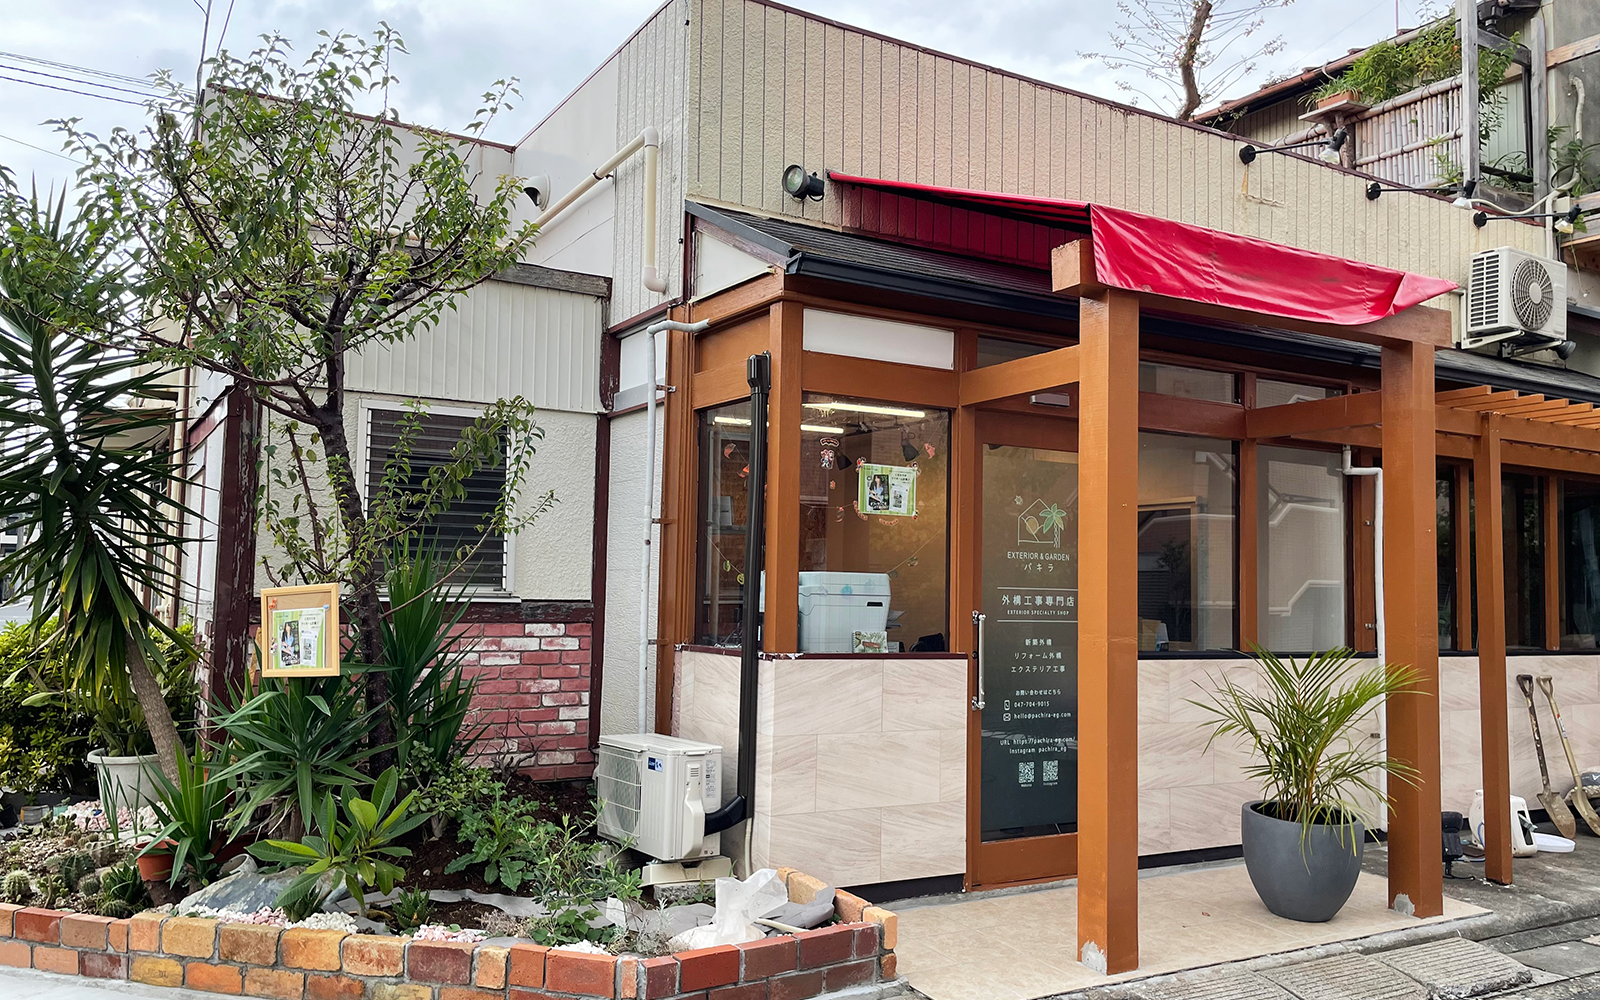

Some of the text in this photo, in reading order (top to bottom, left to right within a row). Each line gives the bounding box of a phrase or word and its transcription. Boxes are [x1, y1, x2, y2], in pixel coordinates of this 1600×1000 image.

[1007, 551, 1070, 561] EXTERIOR & GARDEN
[1023, 562, 1054, 573] パキラ
[1001, 594, 1075, 607] 外構工事専門店
[1025, 638, 1052, 646] 新築外構
[1014, 652, 1062, 660] リフォーム外構
[1011, 665, 1066, 673] エクステリア工事
